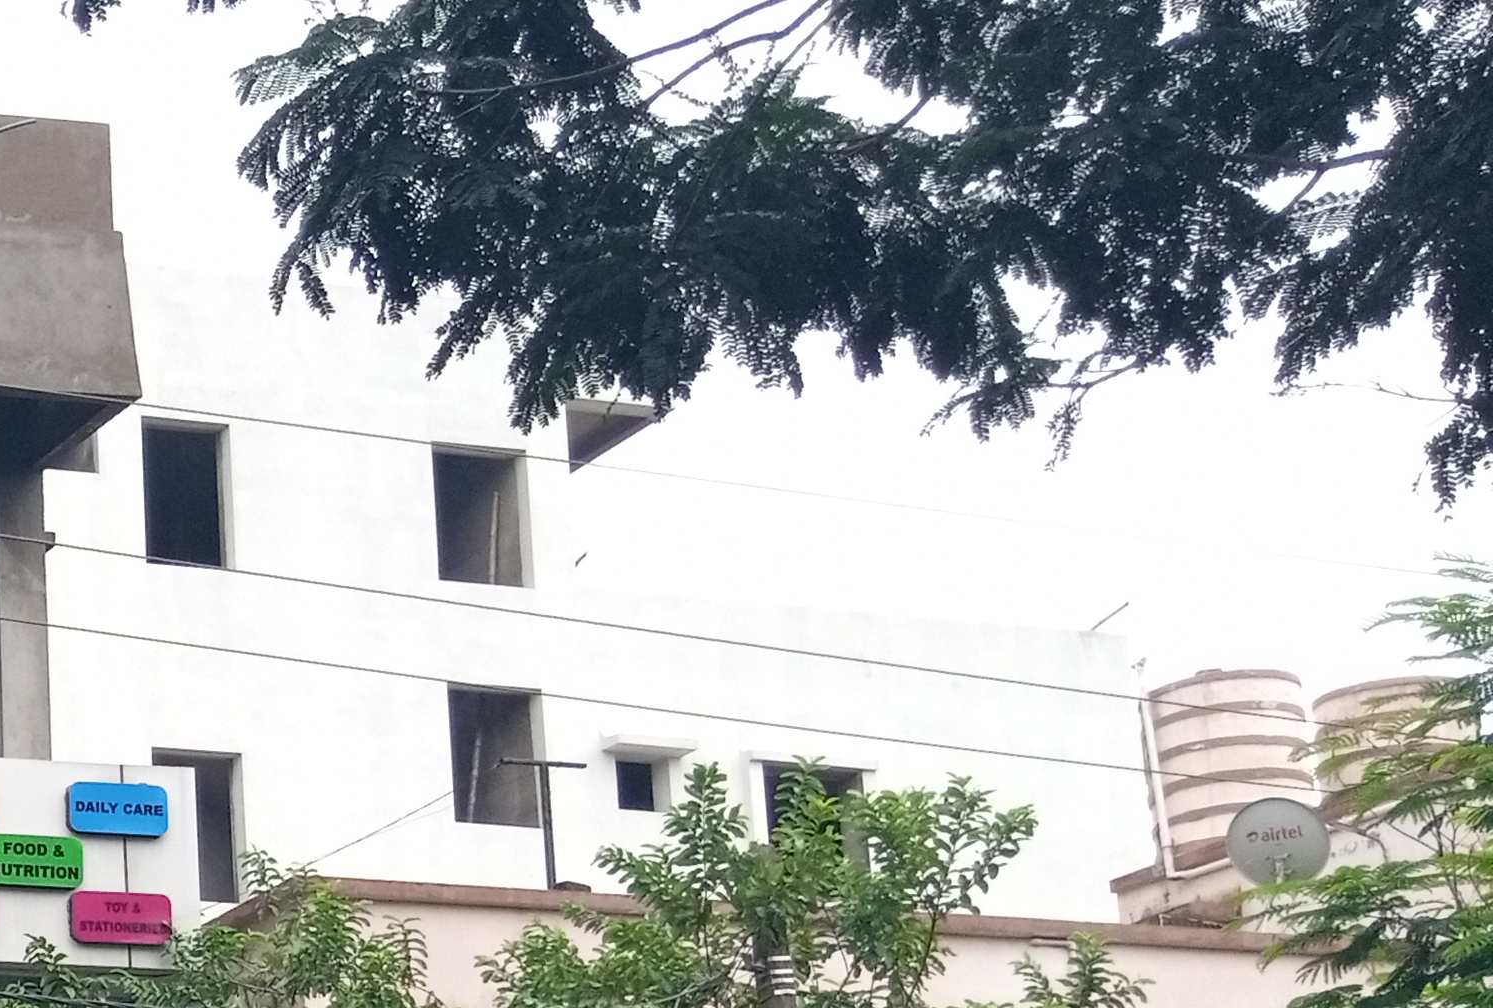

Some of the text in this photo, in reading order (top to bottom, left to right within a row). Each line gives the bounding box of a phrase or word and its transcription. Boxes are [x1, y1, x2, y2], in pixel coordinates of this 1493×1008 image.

[75, 800, 164, 817] DAILY CARE
[1261, 825, 1303, 842] airtel
[3, 842, 65, 858] FOOD &
[104, 902, 141, 914] TOY &
